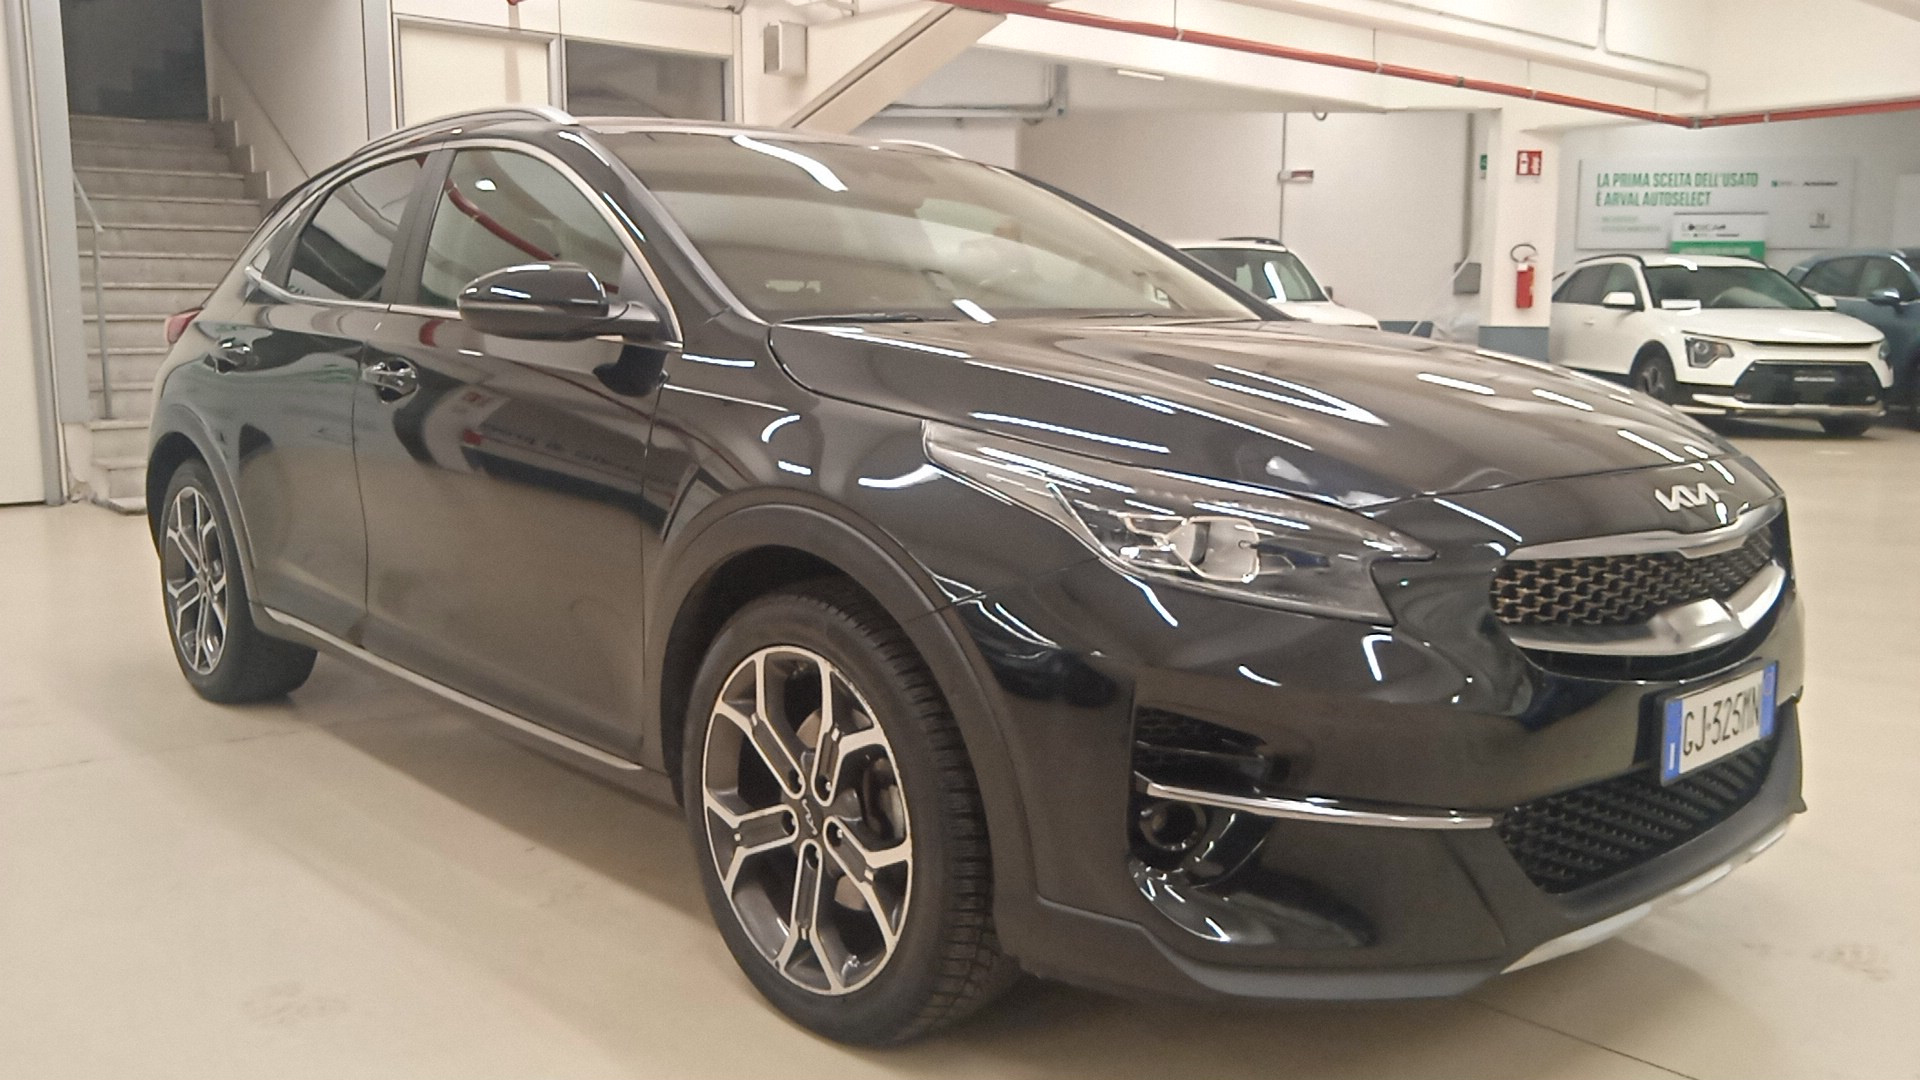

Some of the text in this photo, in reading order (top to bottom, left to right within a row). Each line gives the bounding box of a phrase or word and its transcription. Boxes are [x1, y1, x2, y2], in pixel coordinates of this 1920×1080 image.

[1597, 172, 1610, 188] LA
[1612, 172, 1650, 188] PRIMA
[1653, 172, 1691, 188] SCELTA
[1604, 191, 1640, 206] ARVAL
[1642, 190, 1711, 206] AUTOSELECT
